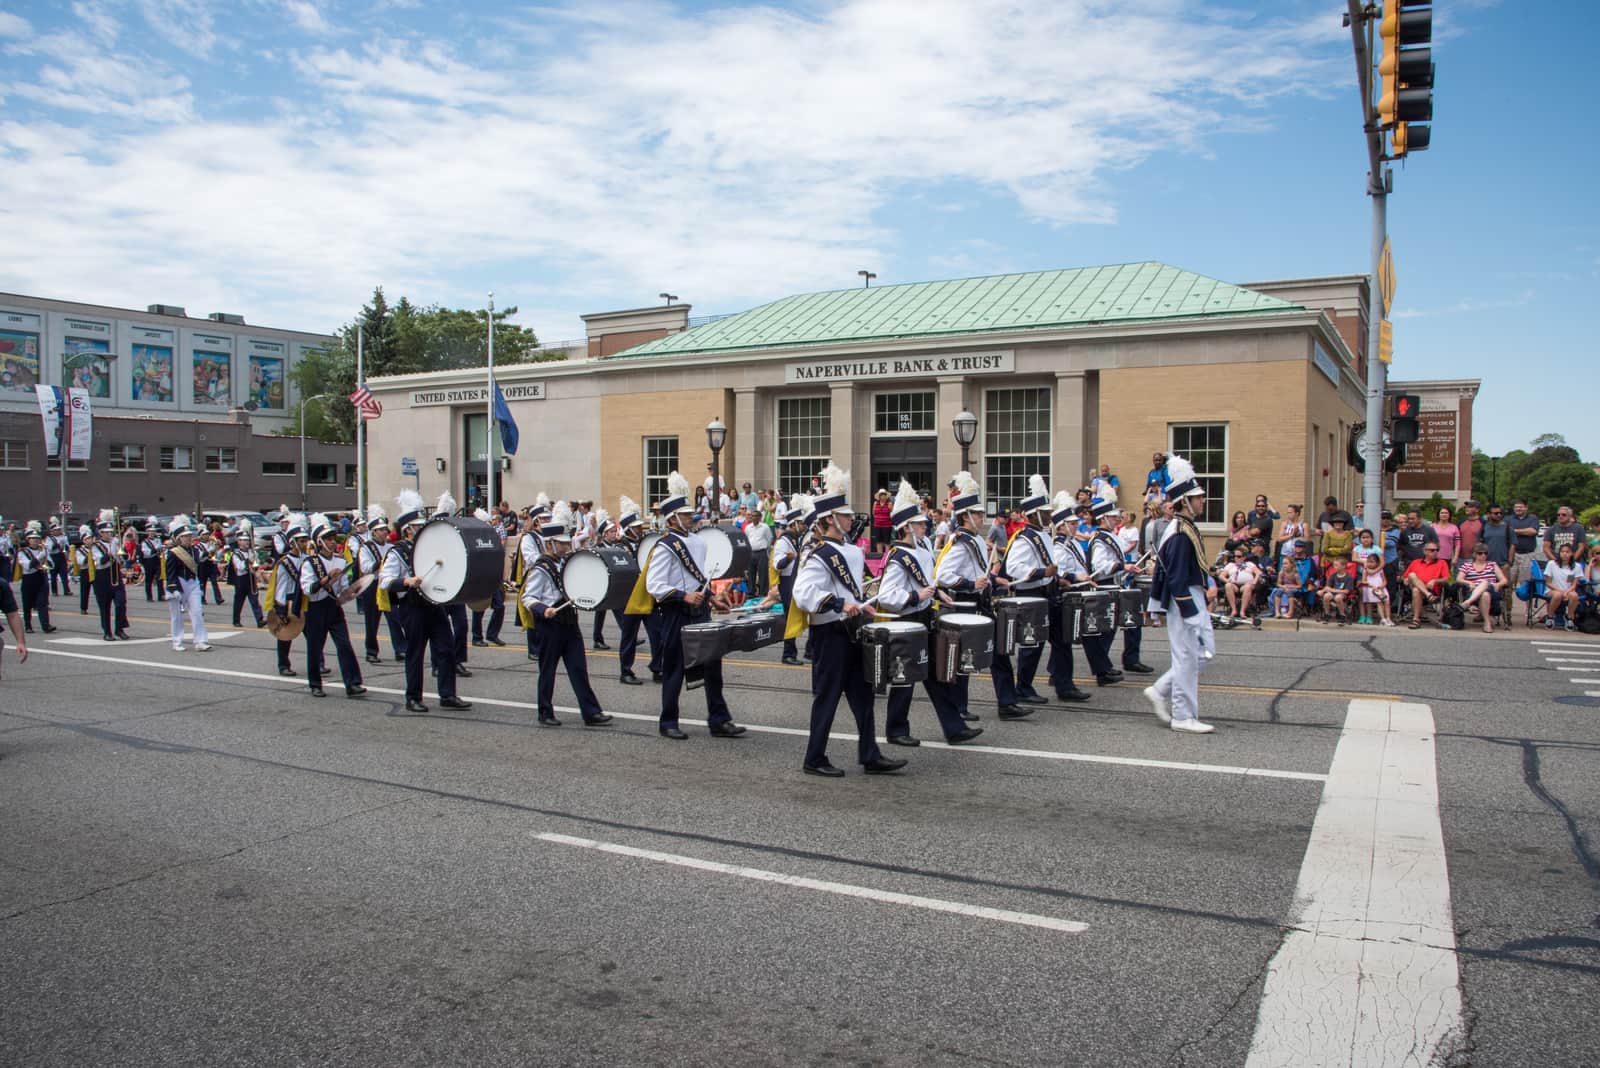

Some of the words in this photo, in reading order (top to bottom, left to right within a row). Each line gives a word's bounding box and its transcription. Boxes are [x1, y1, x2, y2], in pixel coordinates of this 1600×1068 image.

[795, 361, 888, 379] NAPERVILLE
[893, 359, 934, 374] BANK
[937, 359, 950, 371] &
[951, 355, 1003, 370] TRUST
[414, 391, 446, 404] UNITED
[447, 390, 479, 401] STATES
[505, 385, 539, 398] OFFICE
